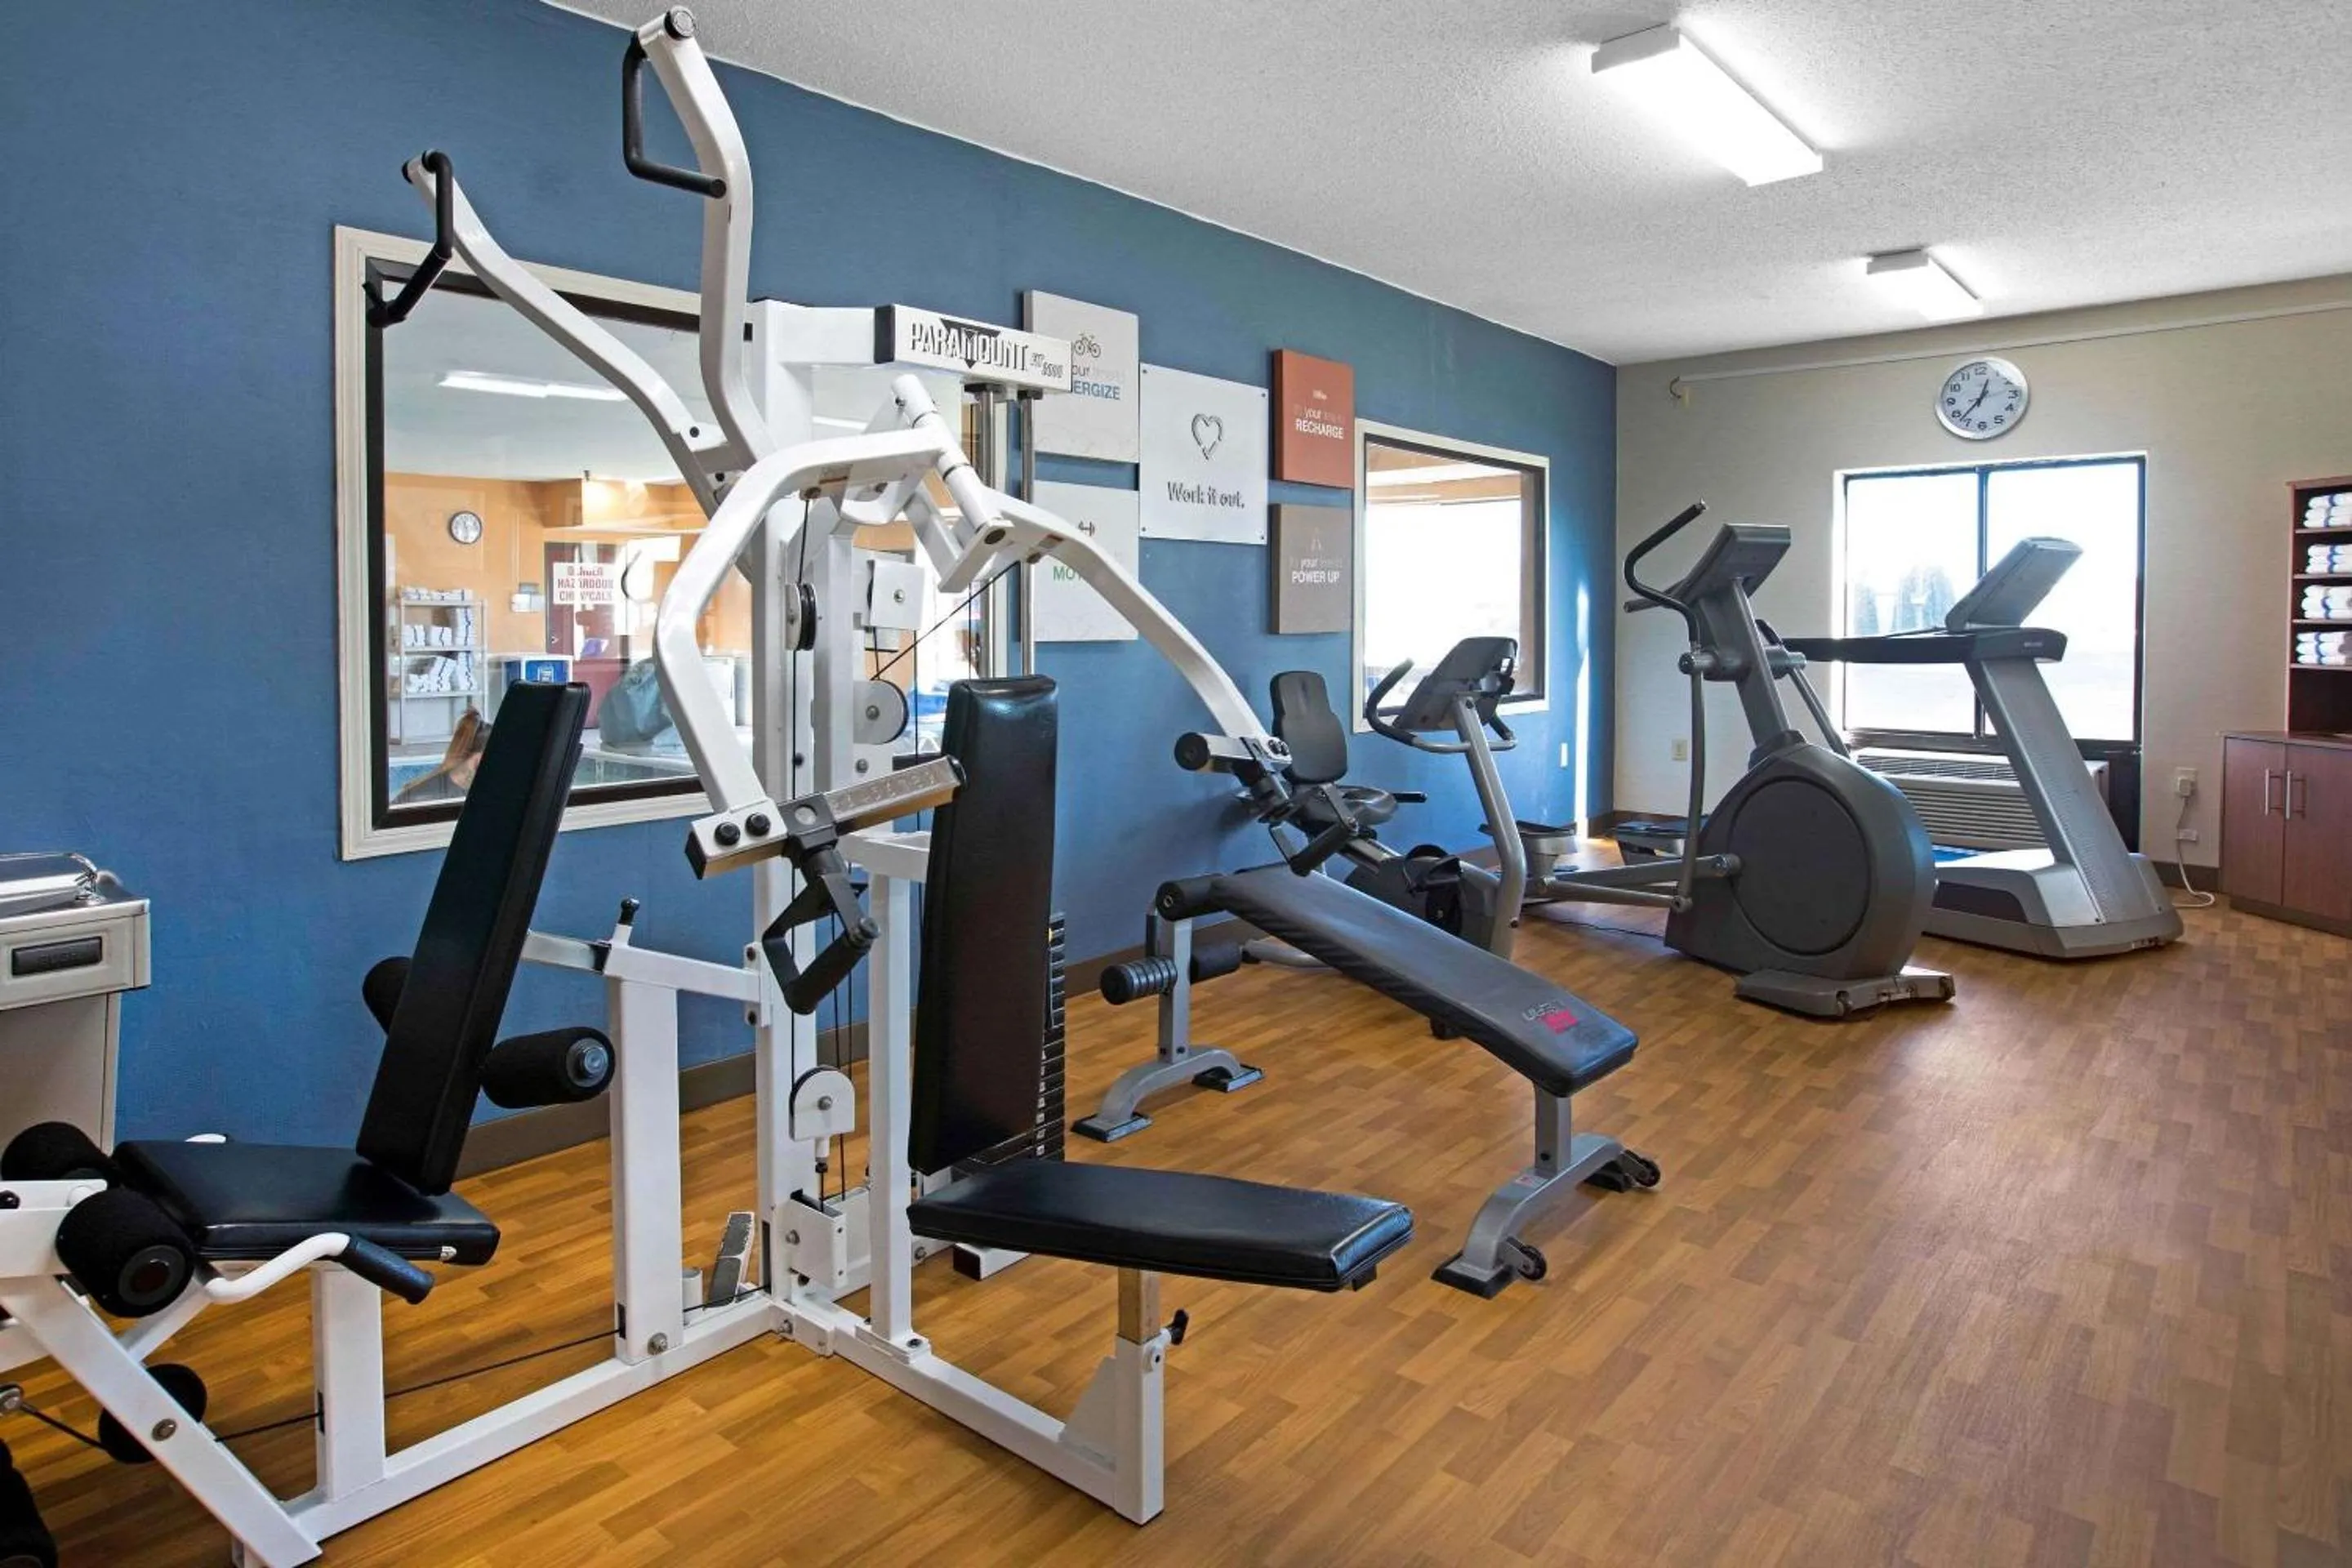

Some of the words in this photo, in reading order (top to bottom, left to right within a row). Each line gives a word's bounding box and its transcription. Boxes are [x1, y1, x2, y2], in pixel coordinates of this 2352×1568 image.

[911, 323, 1029, 371] PARAMOUNT
[1975, 367, 1987, 376] 12
[1295, 417, 1344, 440] RECHARGE
[1167, 481, 1205, 504] Work
[1207, 485, 1216, 506] it
[1219, 491, 1245, 510] out.
[1053, 565, 1081, 581] MO
[1292, 570, 1325, 584] POWER
[1327, 570, 1340, 583] UP
